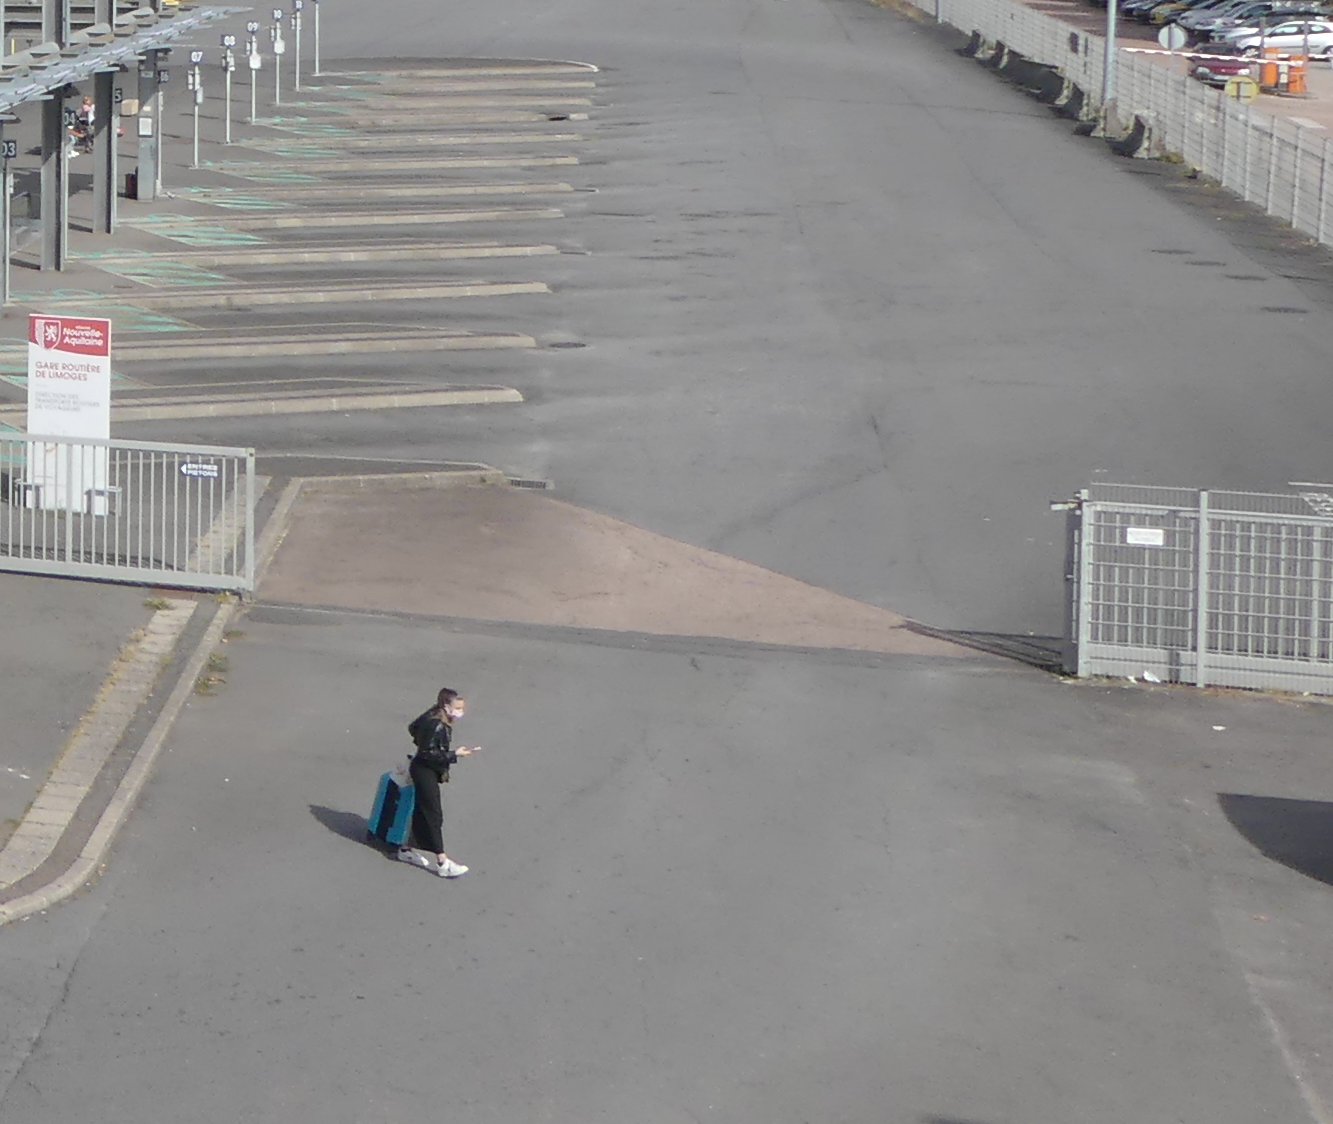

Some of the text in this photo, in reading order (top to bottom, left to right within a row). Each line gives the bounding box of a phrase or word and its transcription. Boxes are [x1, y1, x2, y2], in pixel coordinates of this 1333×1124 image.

[247, 22, 259, 32] 09
[224, 36, 236, 46] 08
[191, 51, 203, 63] 07
[62, 327, 104, 339] Nouvelle-
[62, 336, 104, 347] Aquitaine
[35, 361, 101, 374] GARE ROUTIÈRE
[35, 370, 88, 382] DE LIMOGES
